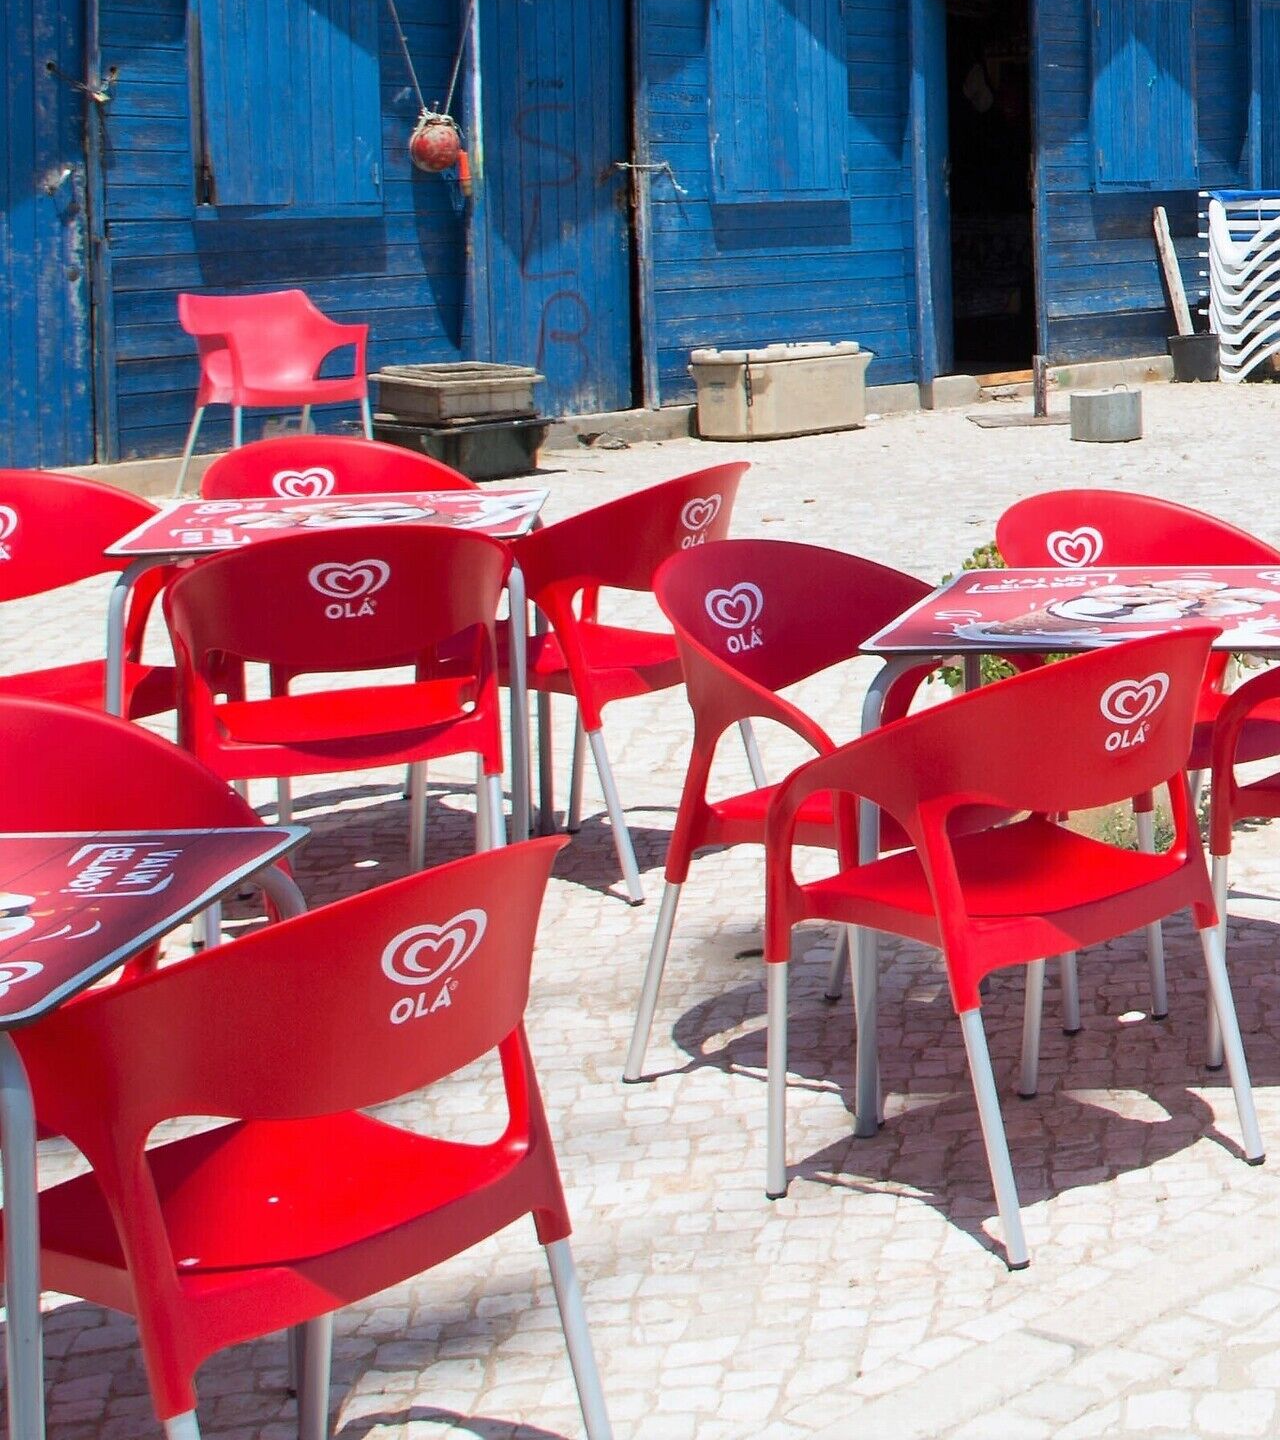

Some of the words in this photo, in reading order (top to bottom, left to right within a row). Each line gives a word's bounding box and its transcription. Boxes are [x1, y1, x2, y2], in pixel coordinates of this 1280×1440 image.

[682, 529, 706, 550] OLÁ
[325, 597, 375, 620] OLÁ
[727, 626, 763, 653] OLÁ
[1104, 720, 1147, 751] OLÁ
[390, 976, 453, 1025] OLÁ
